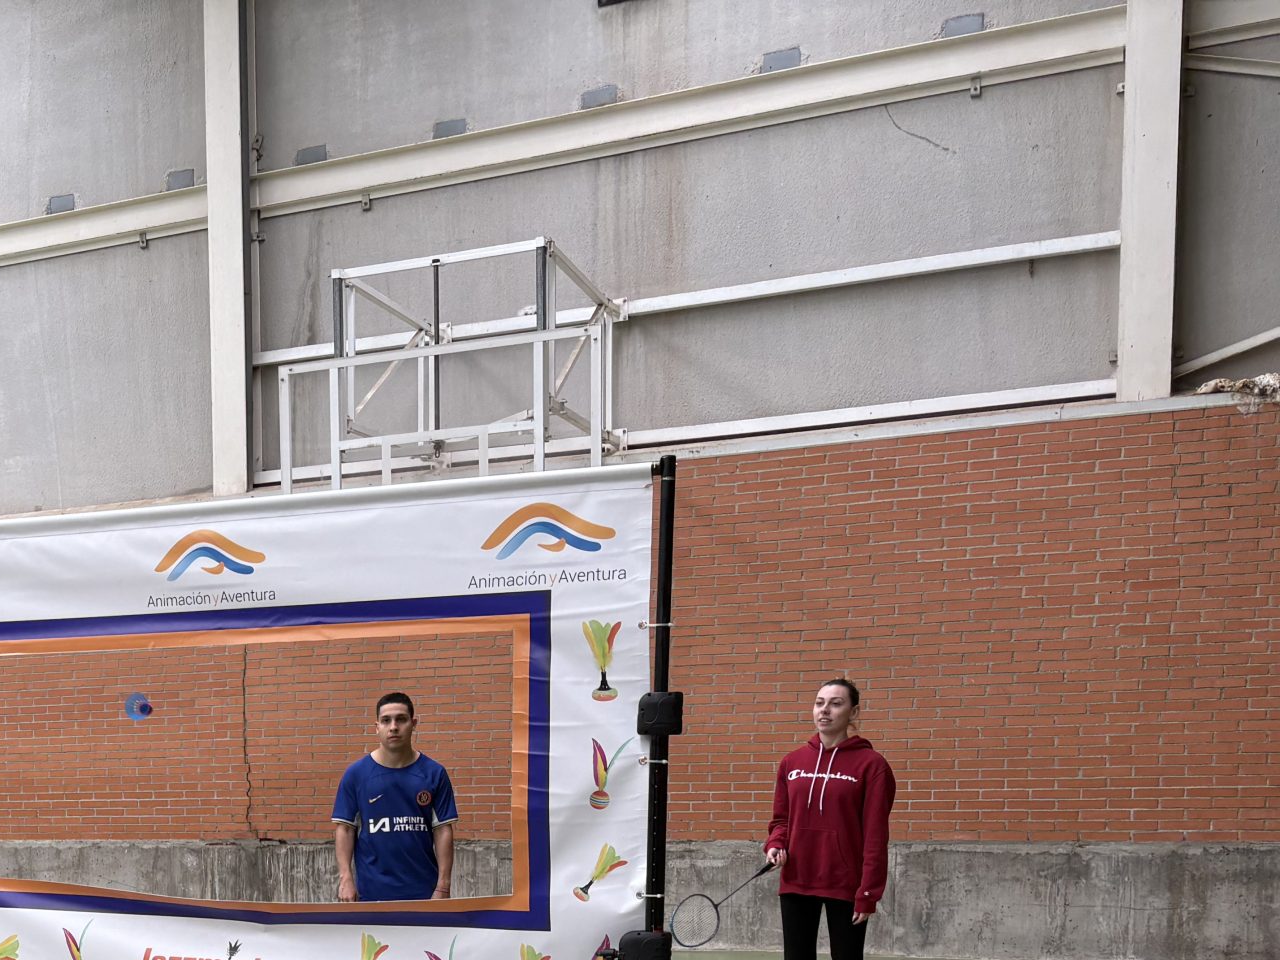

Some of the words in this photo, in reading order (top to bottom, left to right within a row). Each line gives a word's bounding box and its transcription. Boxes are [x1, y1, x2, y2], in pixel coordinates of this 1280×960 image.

[468, 571, 547, 589] Animación
[558, 568, 627, 583] Aventura
[147, 592, 211, 608] Animación
[220, 589, 276, 604] Aventura
[787, 769, 858, 782] Champion
[393, 816, 425, 824] INFINIT
